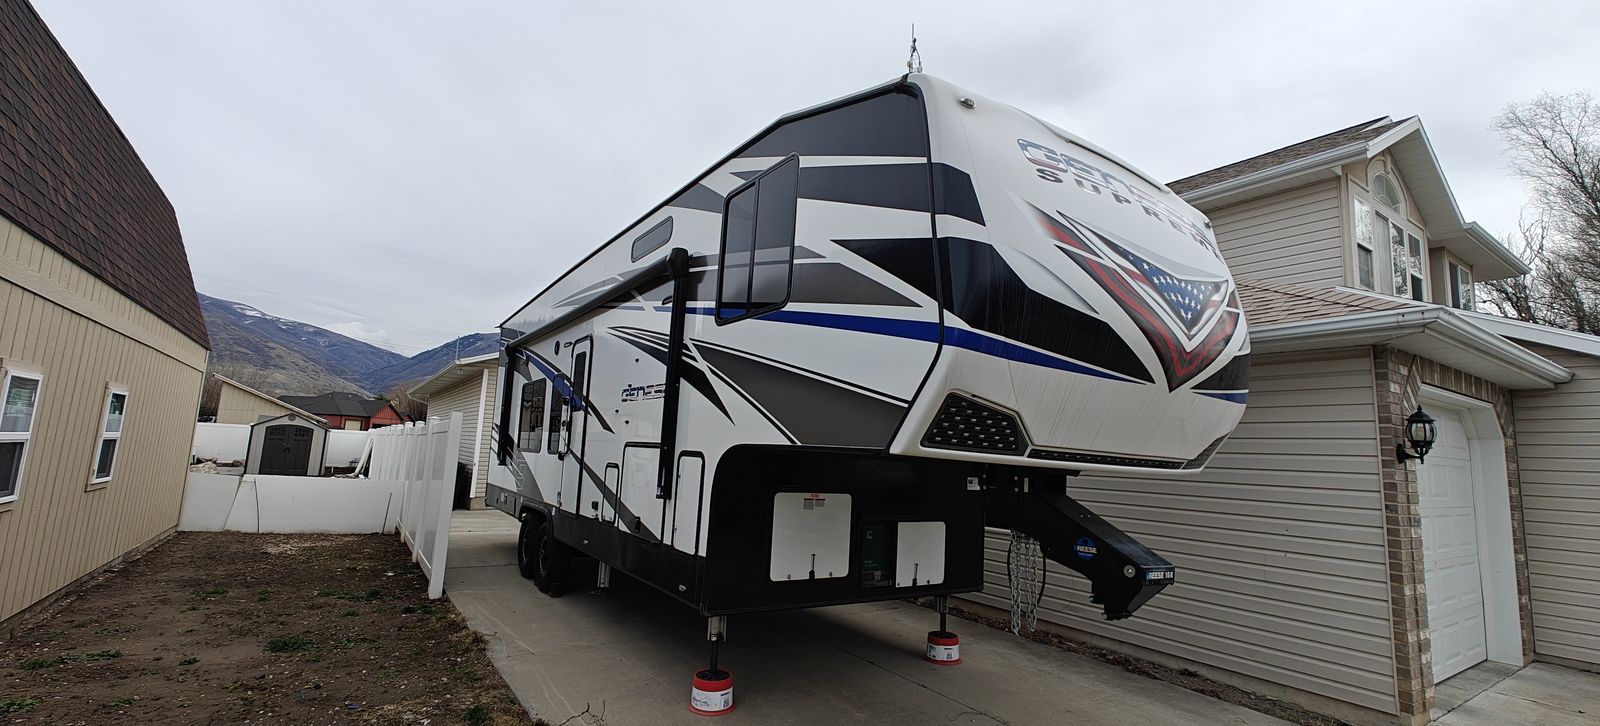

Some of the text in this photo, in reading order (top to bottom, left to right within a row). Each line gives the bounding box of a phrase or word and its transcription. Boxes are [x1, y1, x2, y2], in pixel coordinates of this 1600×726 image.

[621, 383, 665, 402] GENES
[1076, 545, 1097, 554] REESE
[1148, 571, 1165, 579] REESE
